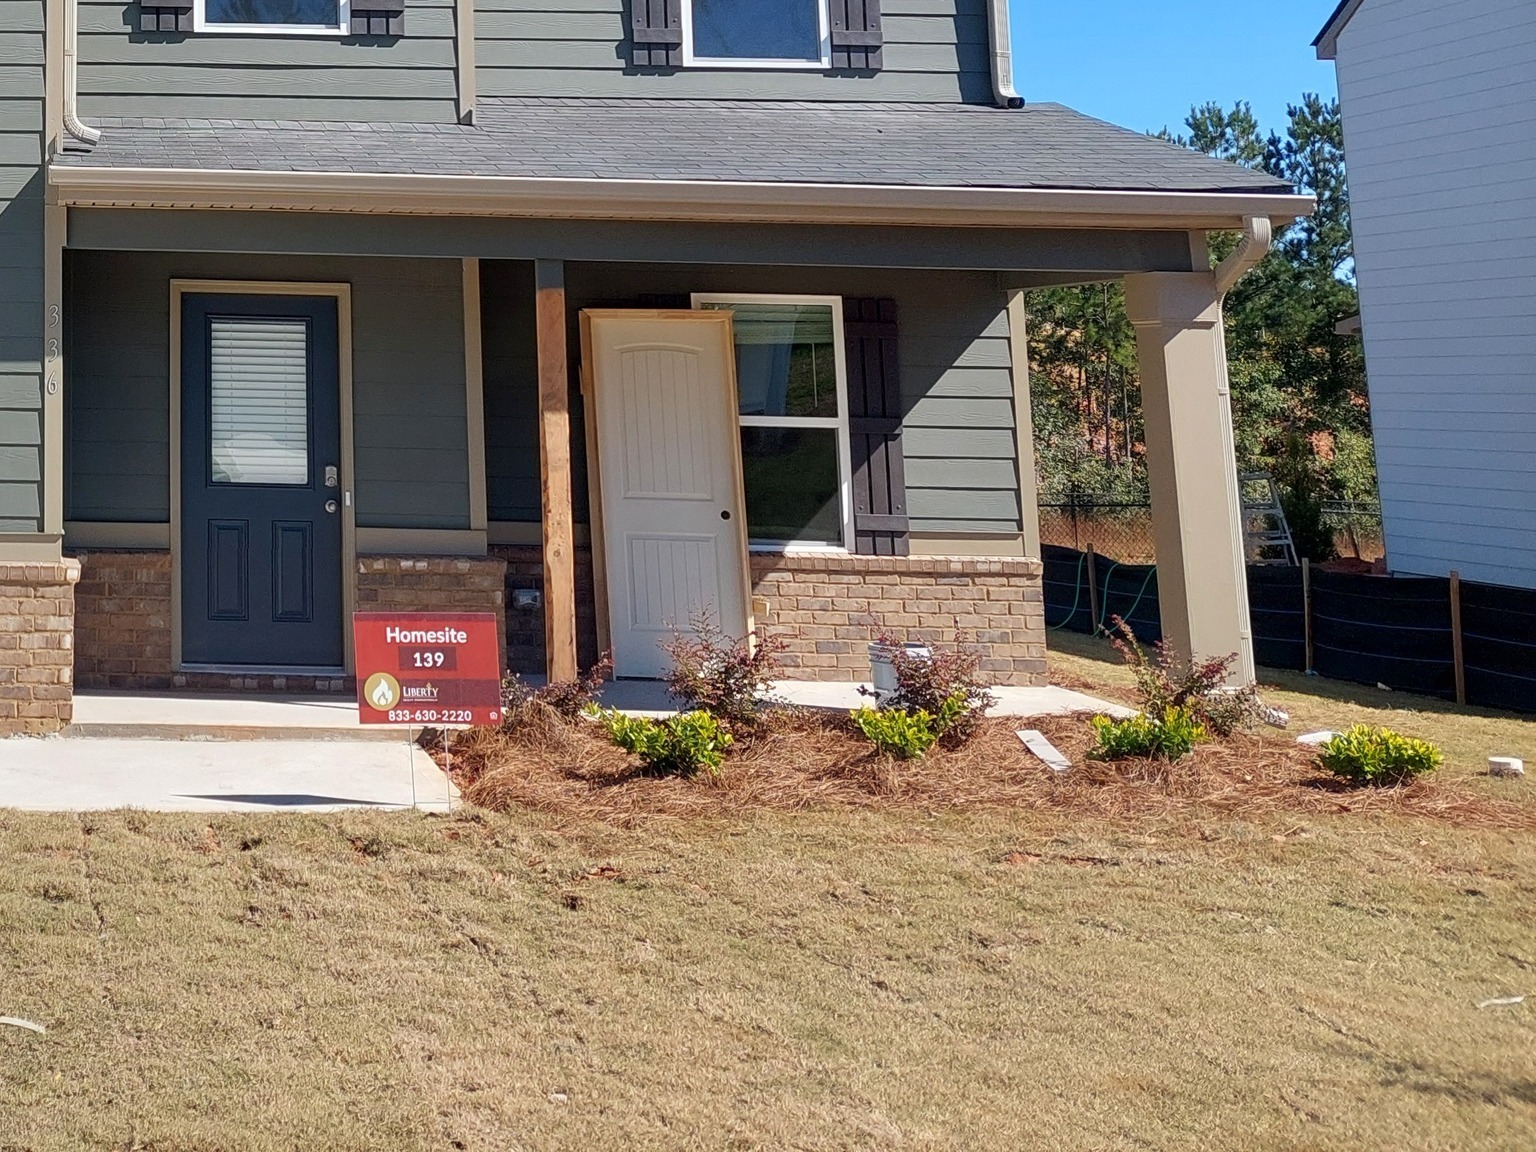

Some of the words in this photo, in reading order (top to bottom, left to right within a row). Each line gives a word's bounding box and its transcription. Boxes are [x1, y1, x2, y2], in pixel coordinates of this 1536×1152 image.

[386, 627, 467, 643] Homesite
[413, 652, 444, 667] 139
[403, 684, 439, 697] LIBERTY
[388, 710, 472, 722] 833-630-2220
